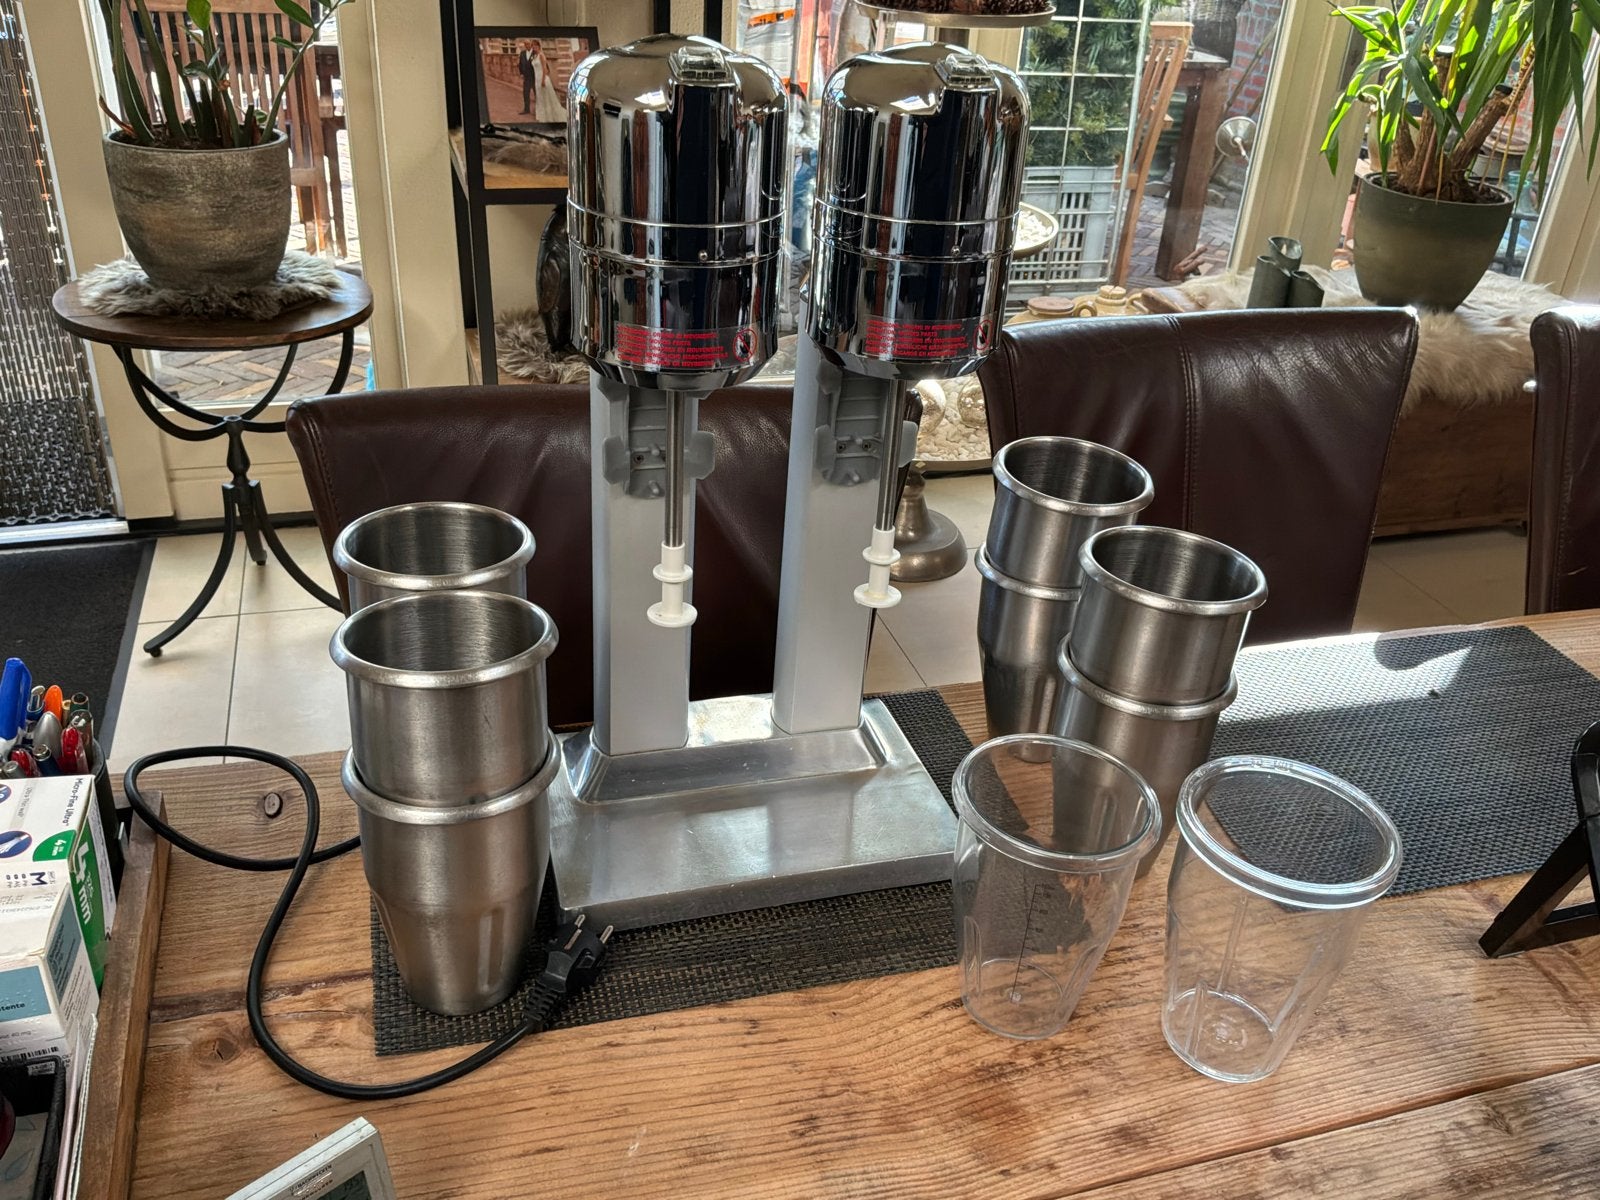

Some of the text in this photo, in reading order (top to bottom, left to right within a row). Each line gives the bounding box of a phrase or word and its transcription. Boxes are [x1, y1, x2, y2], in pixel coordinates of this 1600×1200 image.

[67, 778, 84, 808] Micro-Fine
[29, 872, 48, 886] M
[75, 841, 92, 925] 4 mm
[0, 1003, 25, 1012] tente
